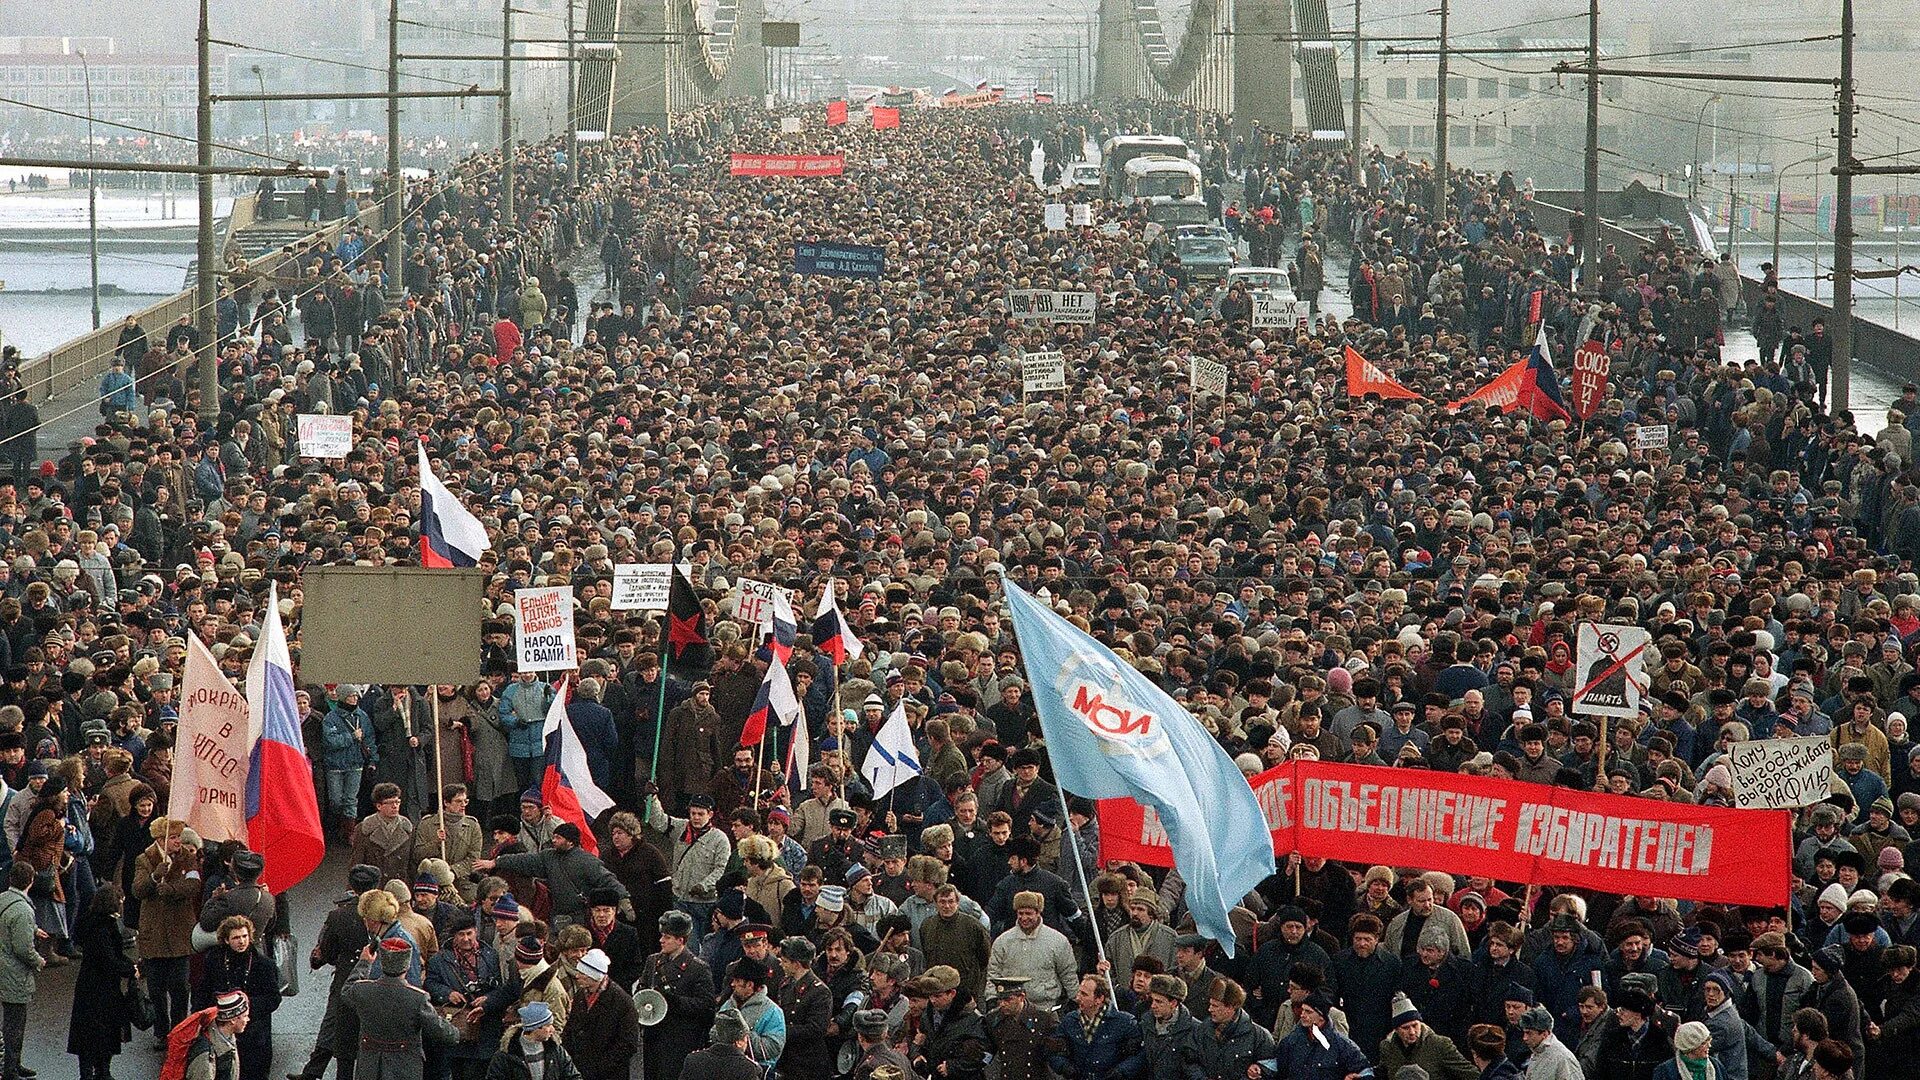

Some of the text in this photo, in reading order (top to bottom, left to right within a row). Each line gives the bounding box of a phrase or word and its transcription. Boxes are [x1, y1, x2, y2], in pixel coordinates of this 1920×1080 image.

[1062, 294, 1084, 307] НЕТ
[1257, 302, 1269, 313] 74
[1285, 302, 1296, 314] УК
[1574, 349, 1611, 376] СОЮЗ
[1581, 372, 1598, 414] ЩИТ
[739, 598, 773, 622] НЕ
[524, 635, 563, 648] НАРОД
[525, 650, 531, 662] С
[1072, 685, 1152, 734] МОИ
[1586, 693, 1623, 705] ПАМЯТЬ
[218, 722, 232, 738] В
[193, 733, 238, 778] КПСС
[199, 787, 237, 809] ОРМА
[1764, 765, 1830, 808] МАФИЮ
[1302, 777, 1507, 850] ОБЪЕДИНЕНИЕ
[1513, 801, 1714, 877] ИЗБИРАТЕЛЕЙ
